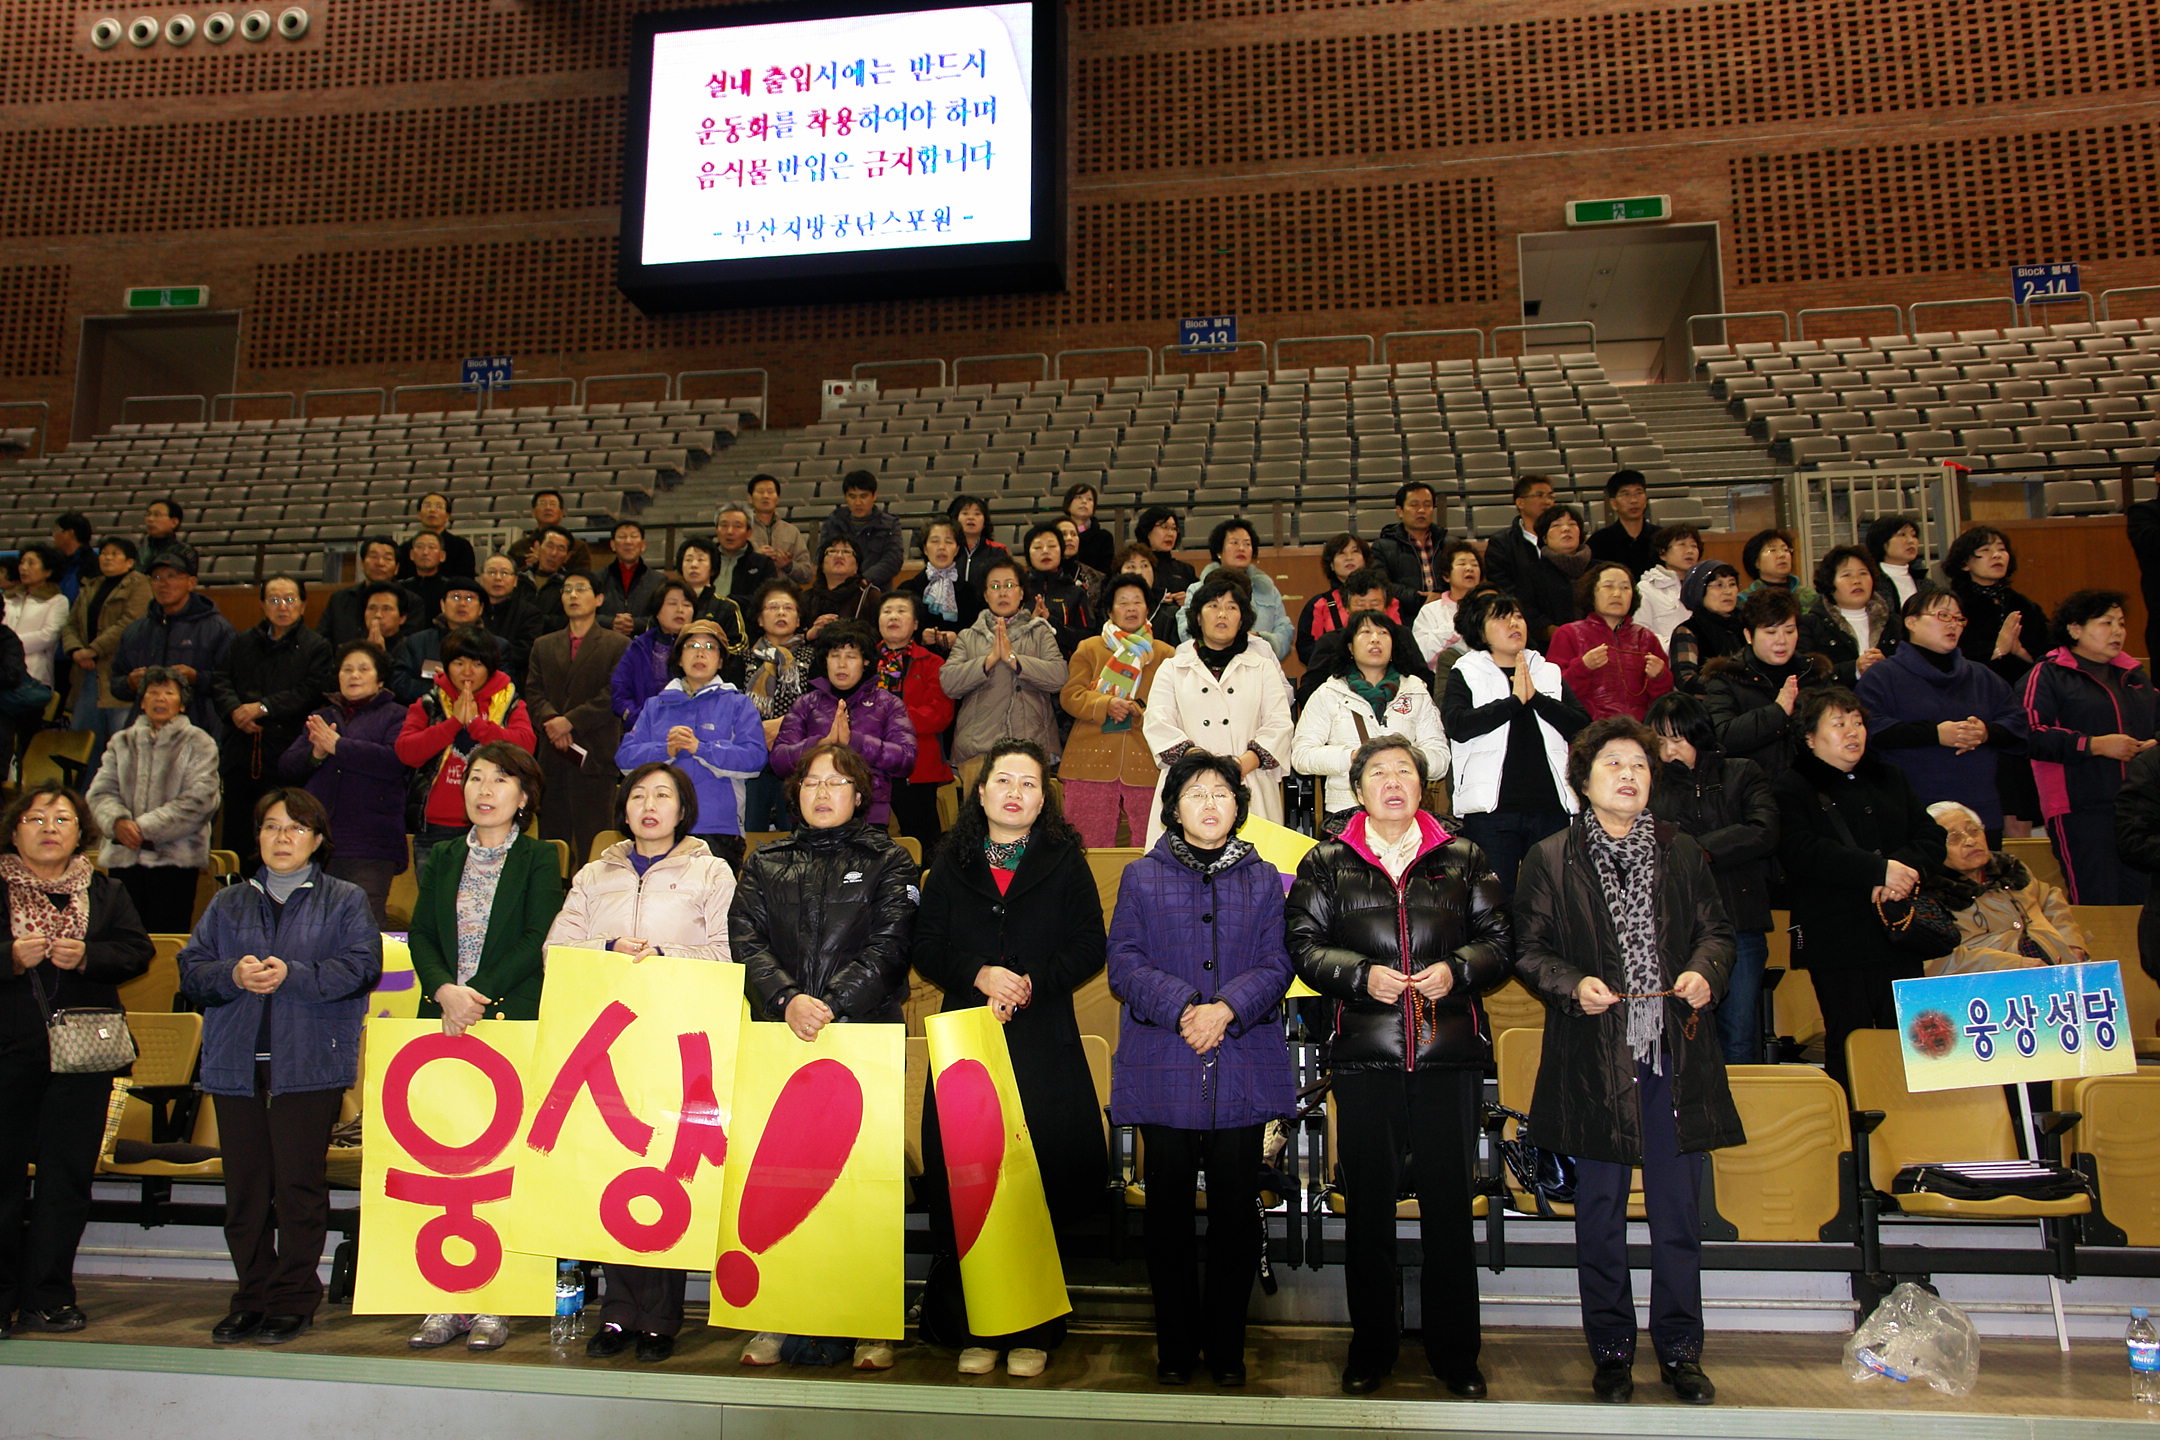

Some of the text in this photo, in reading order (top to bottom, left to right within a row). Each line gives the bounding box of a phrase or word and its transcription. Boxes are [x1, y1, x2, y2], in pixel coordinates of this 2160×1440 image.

[705, 47, 986, 98] 실내 출입시에는 반드시
[696, 94, 996, 145] 운동화를 착용하여야 하며
[863, 139, 996, 178] 금지합니다
[2018, 267, 2046, 278] Block
[1185, 319, 1209, 329] Block
[1190, 330, 1228, 352] 2-13
